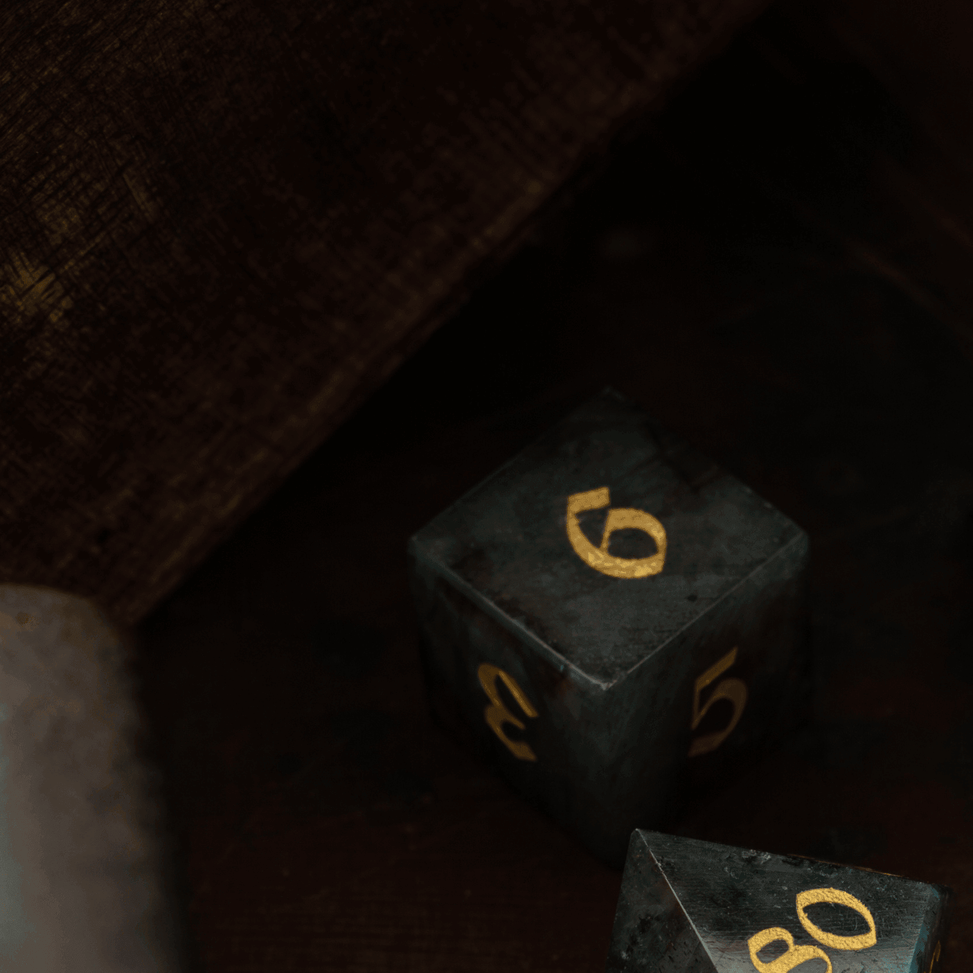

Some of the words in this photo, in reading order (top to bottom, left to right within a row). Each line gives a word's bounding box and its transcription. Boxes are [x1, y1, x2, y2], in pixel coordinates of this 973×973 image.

[566, 487, 667, 579] 6
[478, 664, 537, 760] 3
[689, 647, 747, 757] 5
